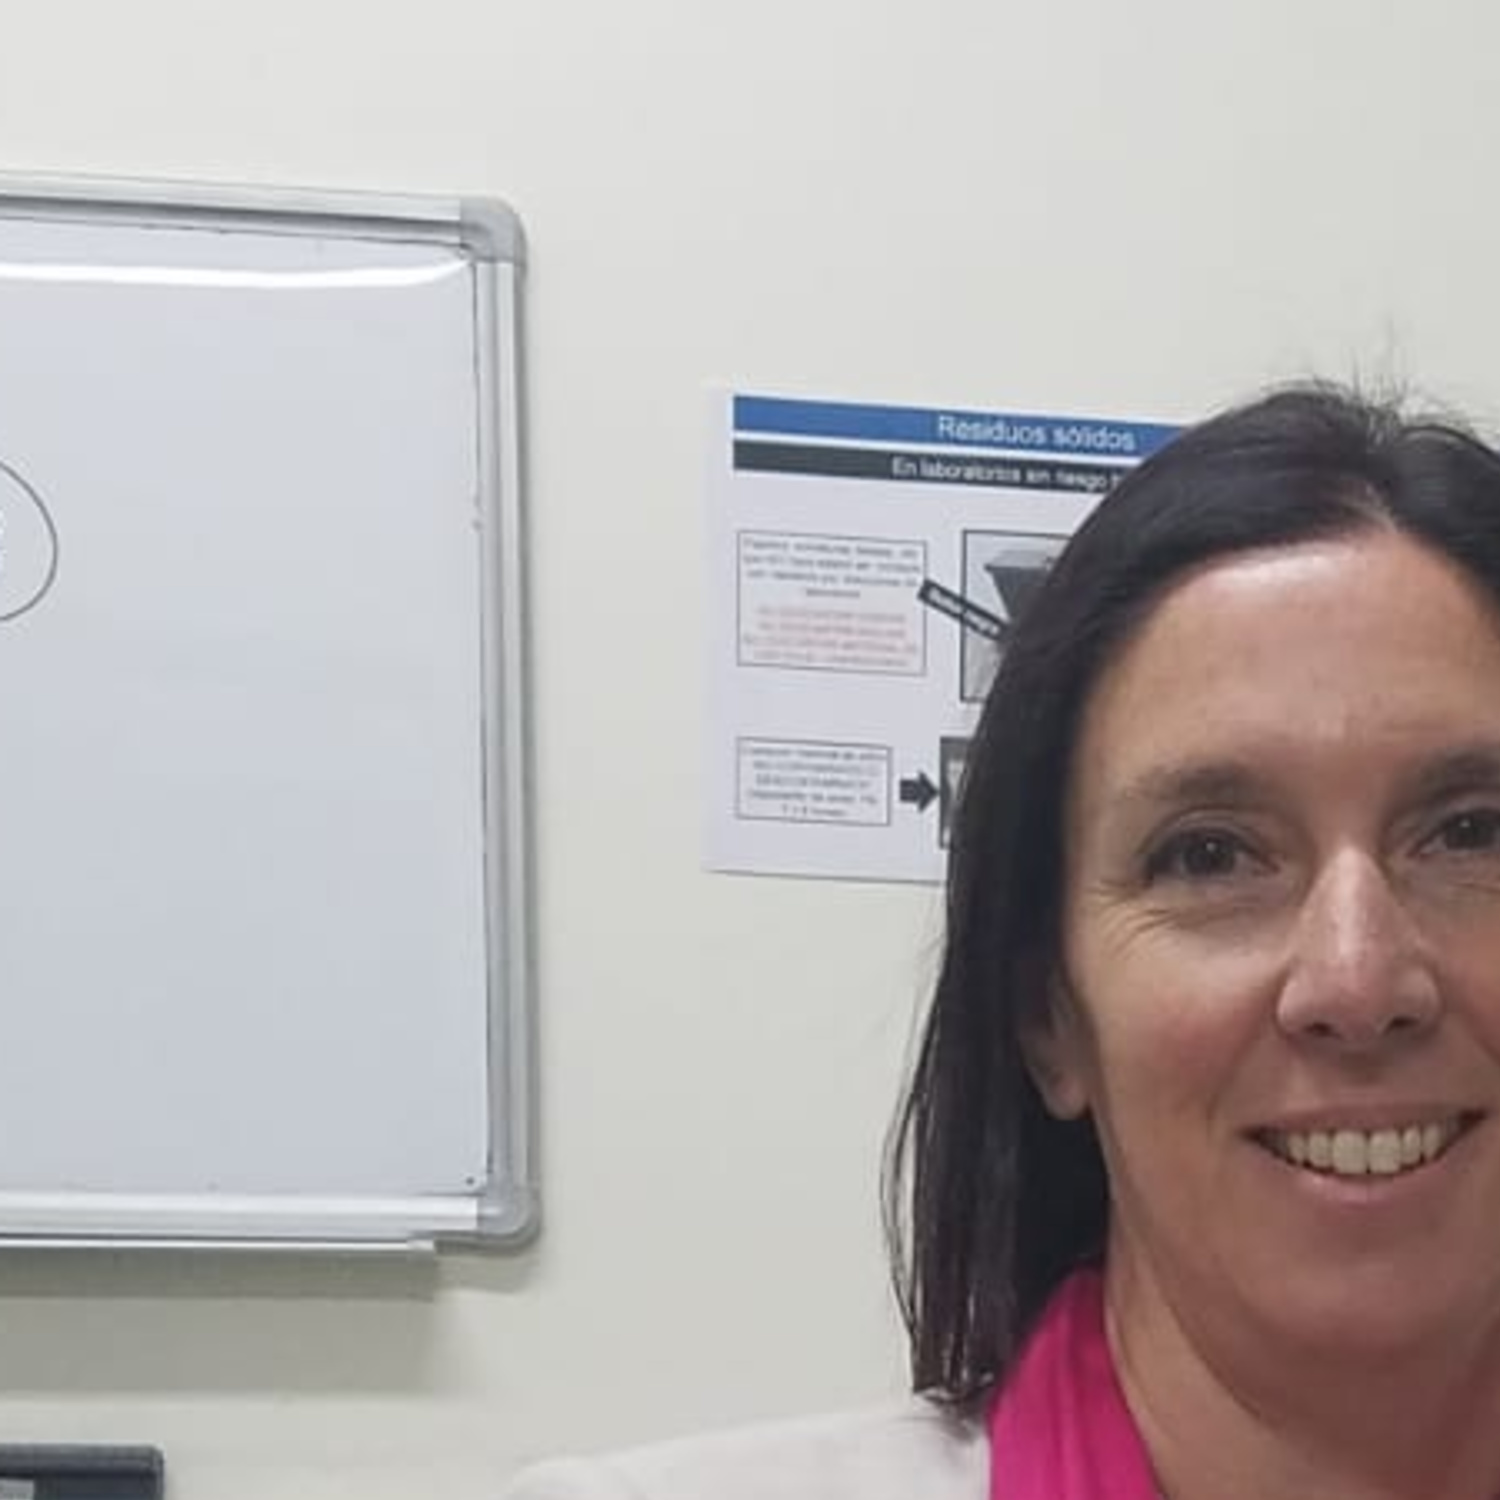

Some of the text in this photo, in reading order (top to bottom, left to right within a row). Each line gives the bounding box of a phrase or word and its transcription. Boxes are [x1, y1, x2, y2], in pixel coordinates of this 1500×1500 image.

[938, 415, 1136, 451] Residuos sólidos
[892, 456, 916, 476] En
